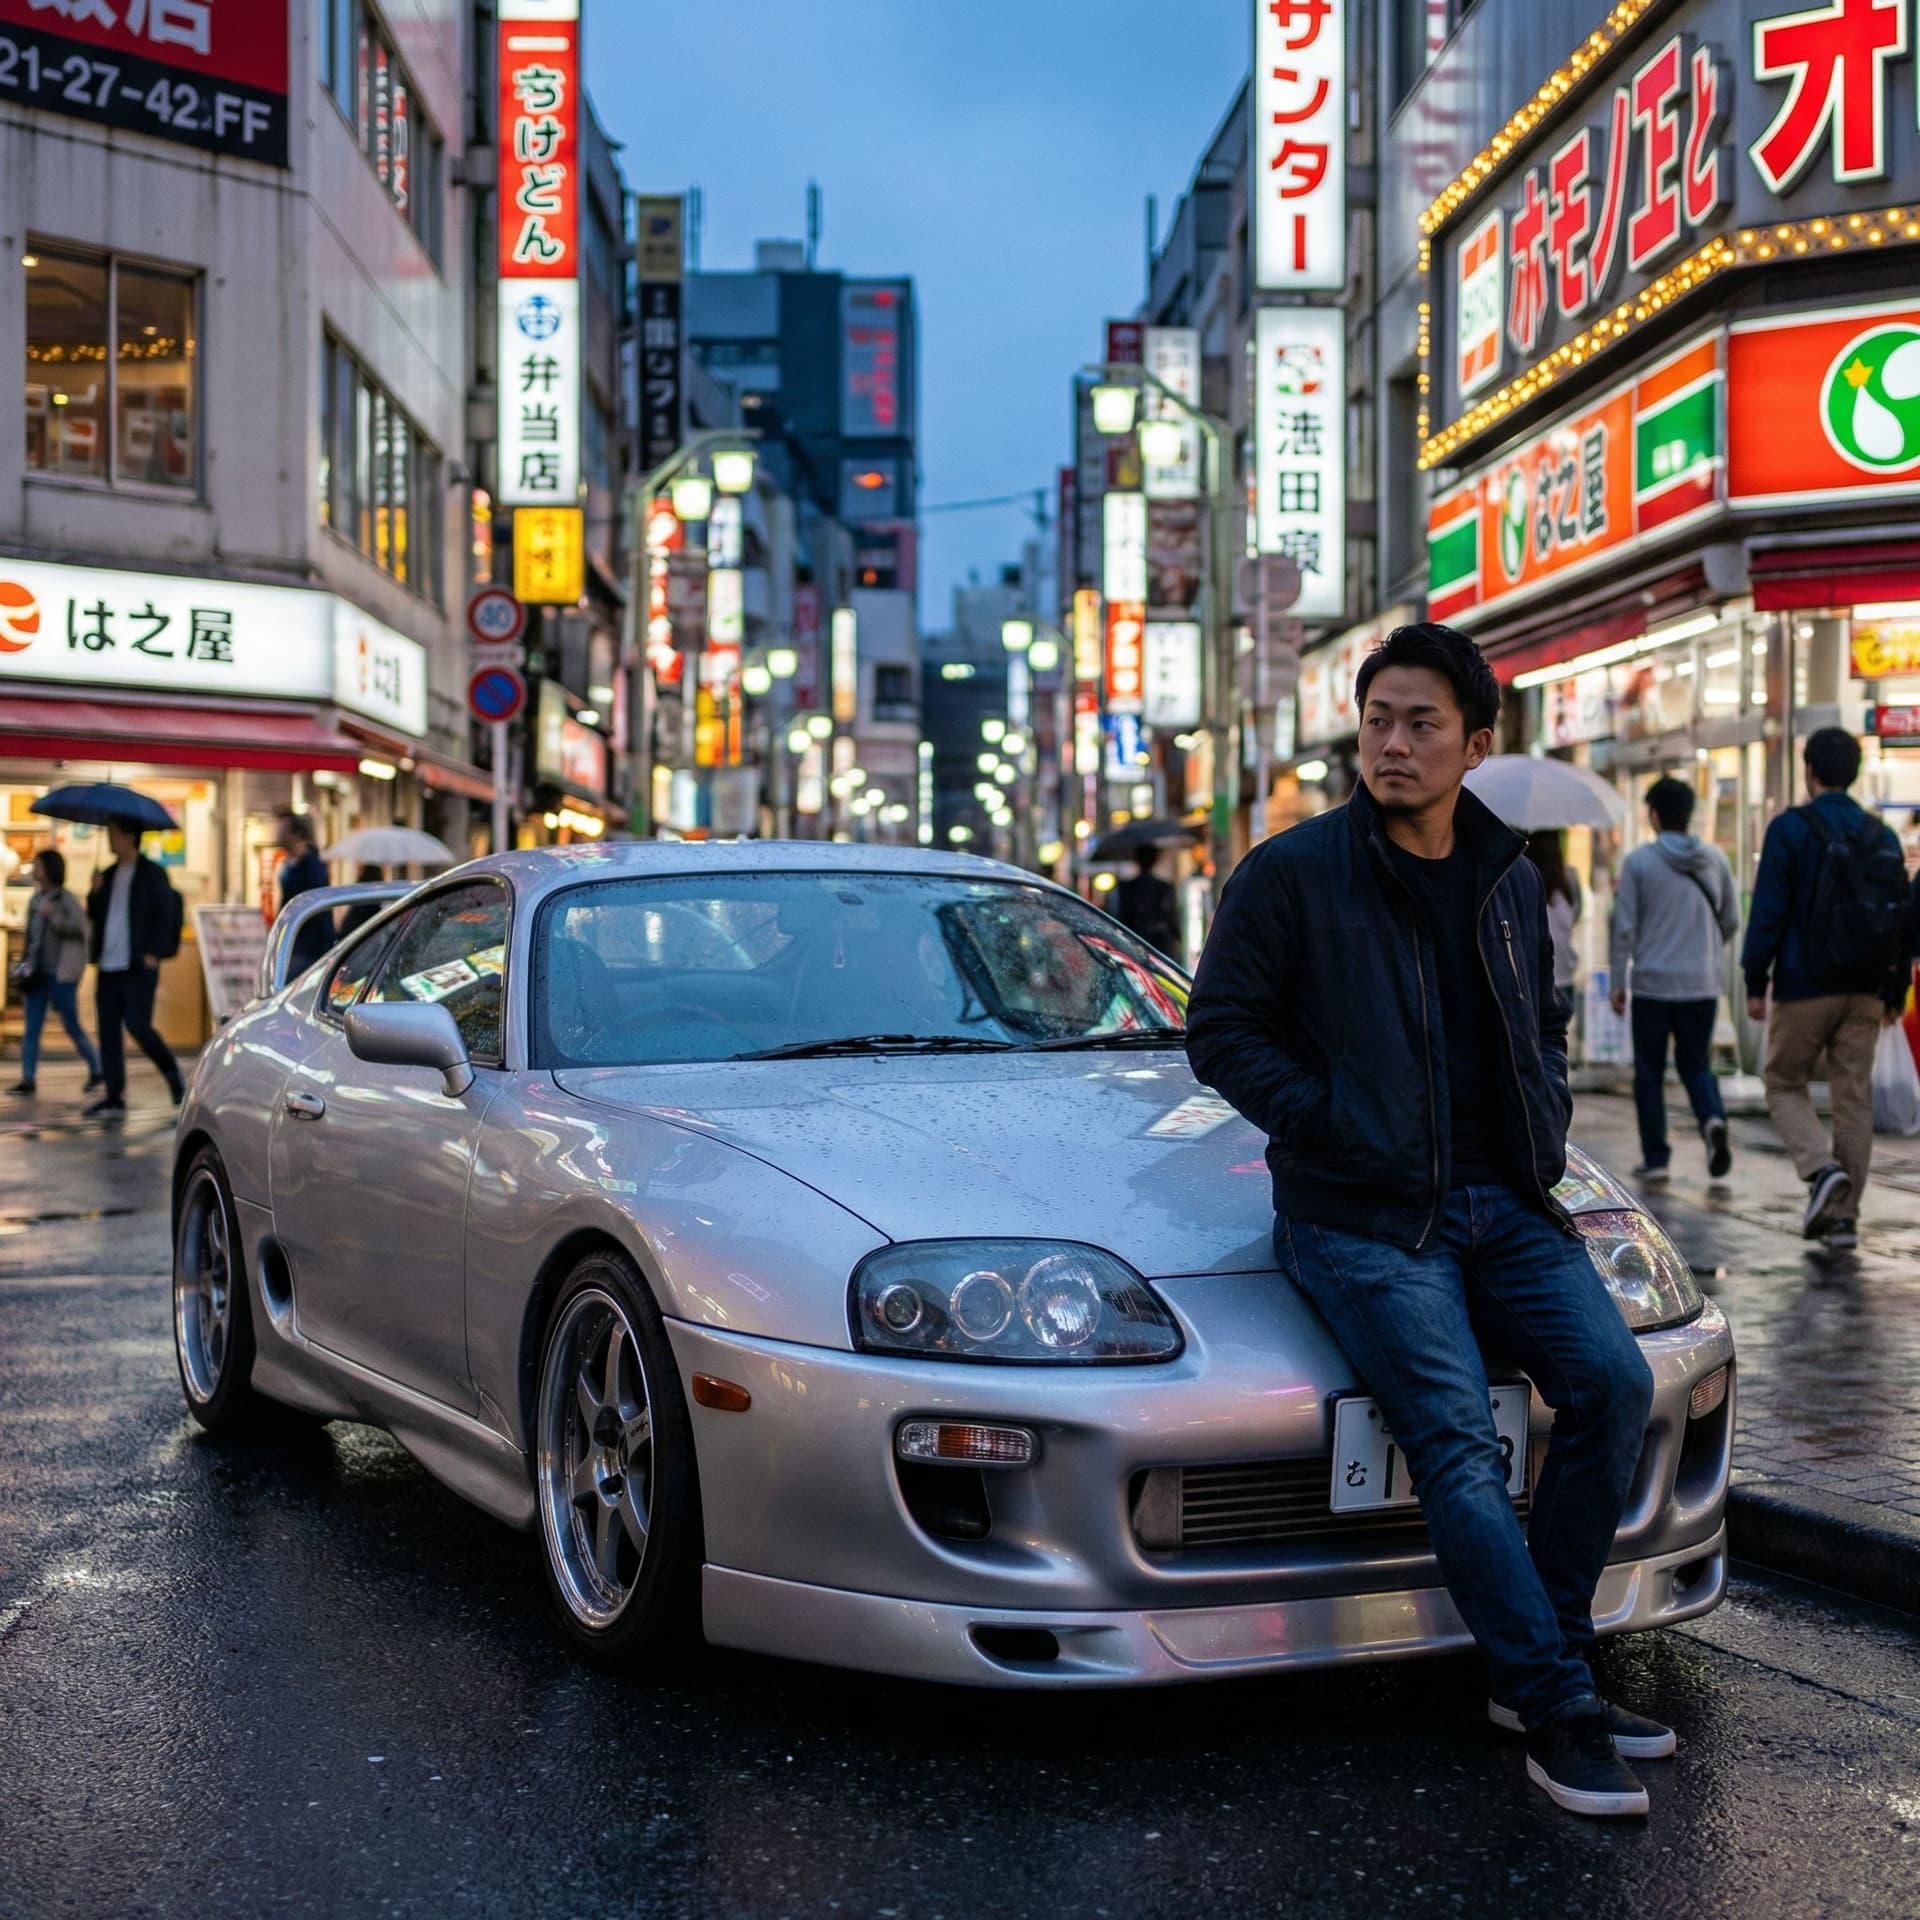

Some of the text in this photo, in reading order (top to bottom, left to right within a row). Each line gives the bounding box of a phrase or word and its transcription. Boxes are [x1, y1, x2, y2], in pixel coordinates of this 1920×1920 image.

[1270, 0, 1332, 271] サンター
[1749, 0, 1920, 193] オ
[519, 353, 561, 491] 弁当店
[66, 598, 235, 662] は之屋
[1346, 1460, 1367, 1487] む
